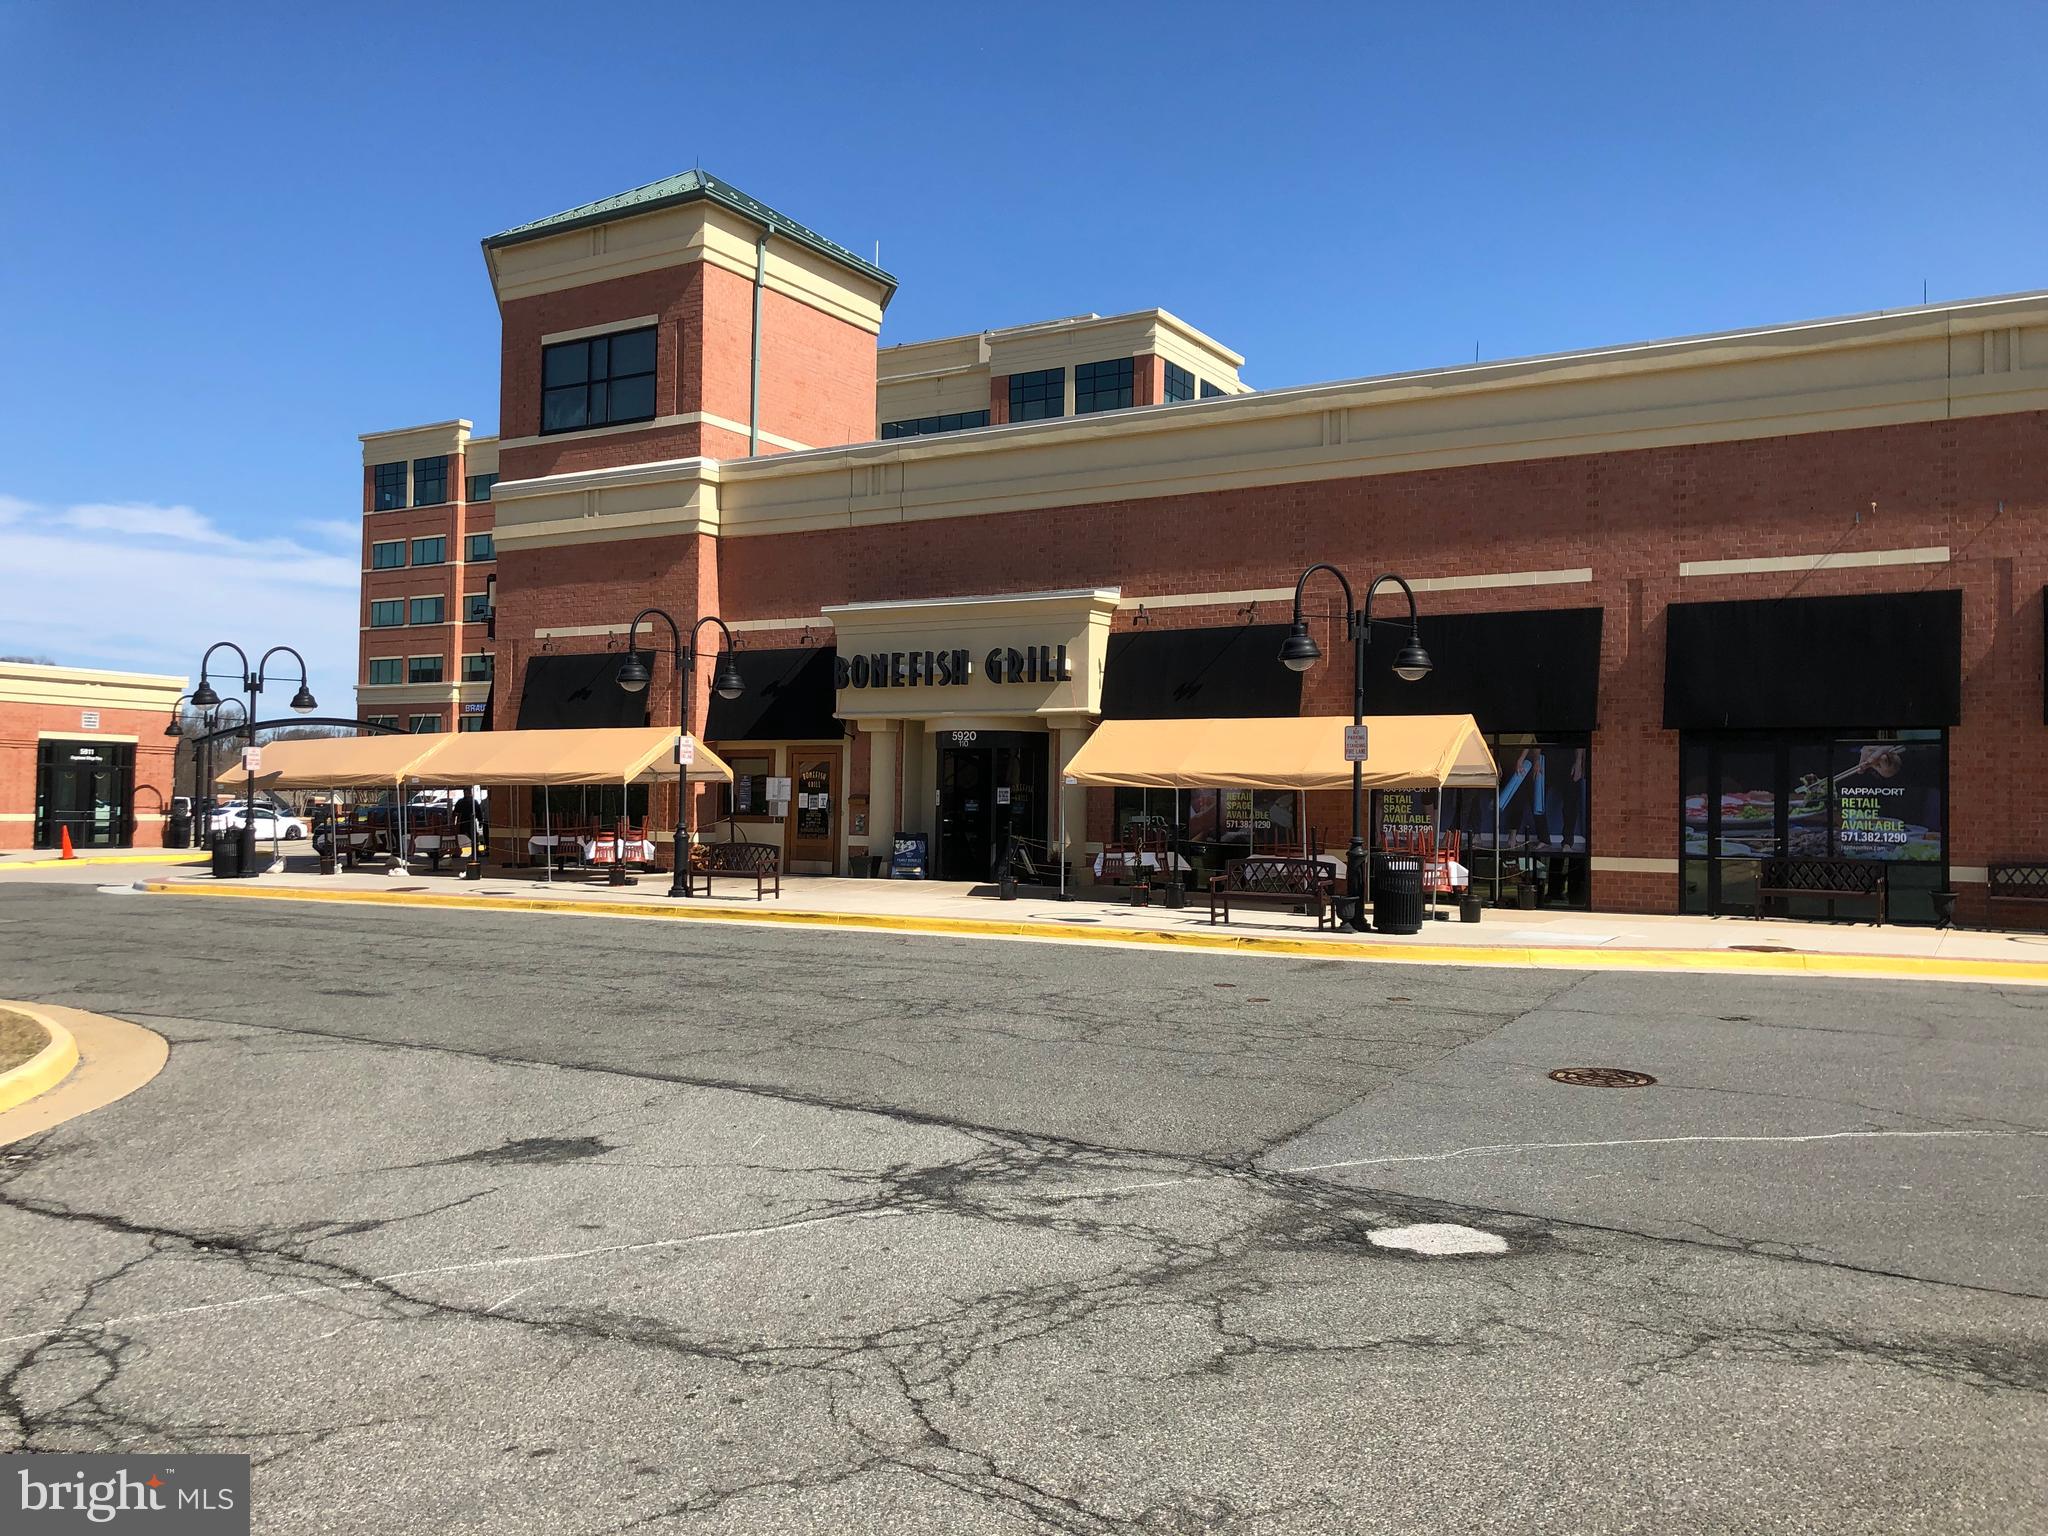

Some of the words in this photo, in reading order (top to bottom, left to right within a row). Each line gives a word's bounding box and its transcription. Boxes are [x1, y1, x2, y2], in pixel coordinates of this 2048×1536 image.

[835, 649, 969, 689] BONEFISH
[985, 645, 1071, 684] GRILL
[952, 731, 977, 741] 5920
[1841, 788, 1905, 796] RAPPAPORT
[1384, 794, 1413, 804] RETAIL
[1841, 798, 1880, 808] RETAIL
[1227, 801, 1252, 810] SPACE
[1384, 804, 1412, 814] SPACE
[1384, 814, 1431, 824] AVAILABLE
[1841, 809, 1879, 819] SPACE
[1226, 820, 1271, 829] 571.3821290
[1841, 821, 1905, 831] AVAILABLE
[1841, 832, 1907, 842] 571.382.1290
